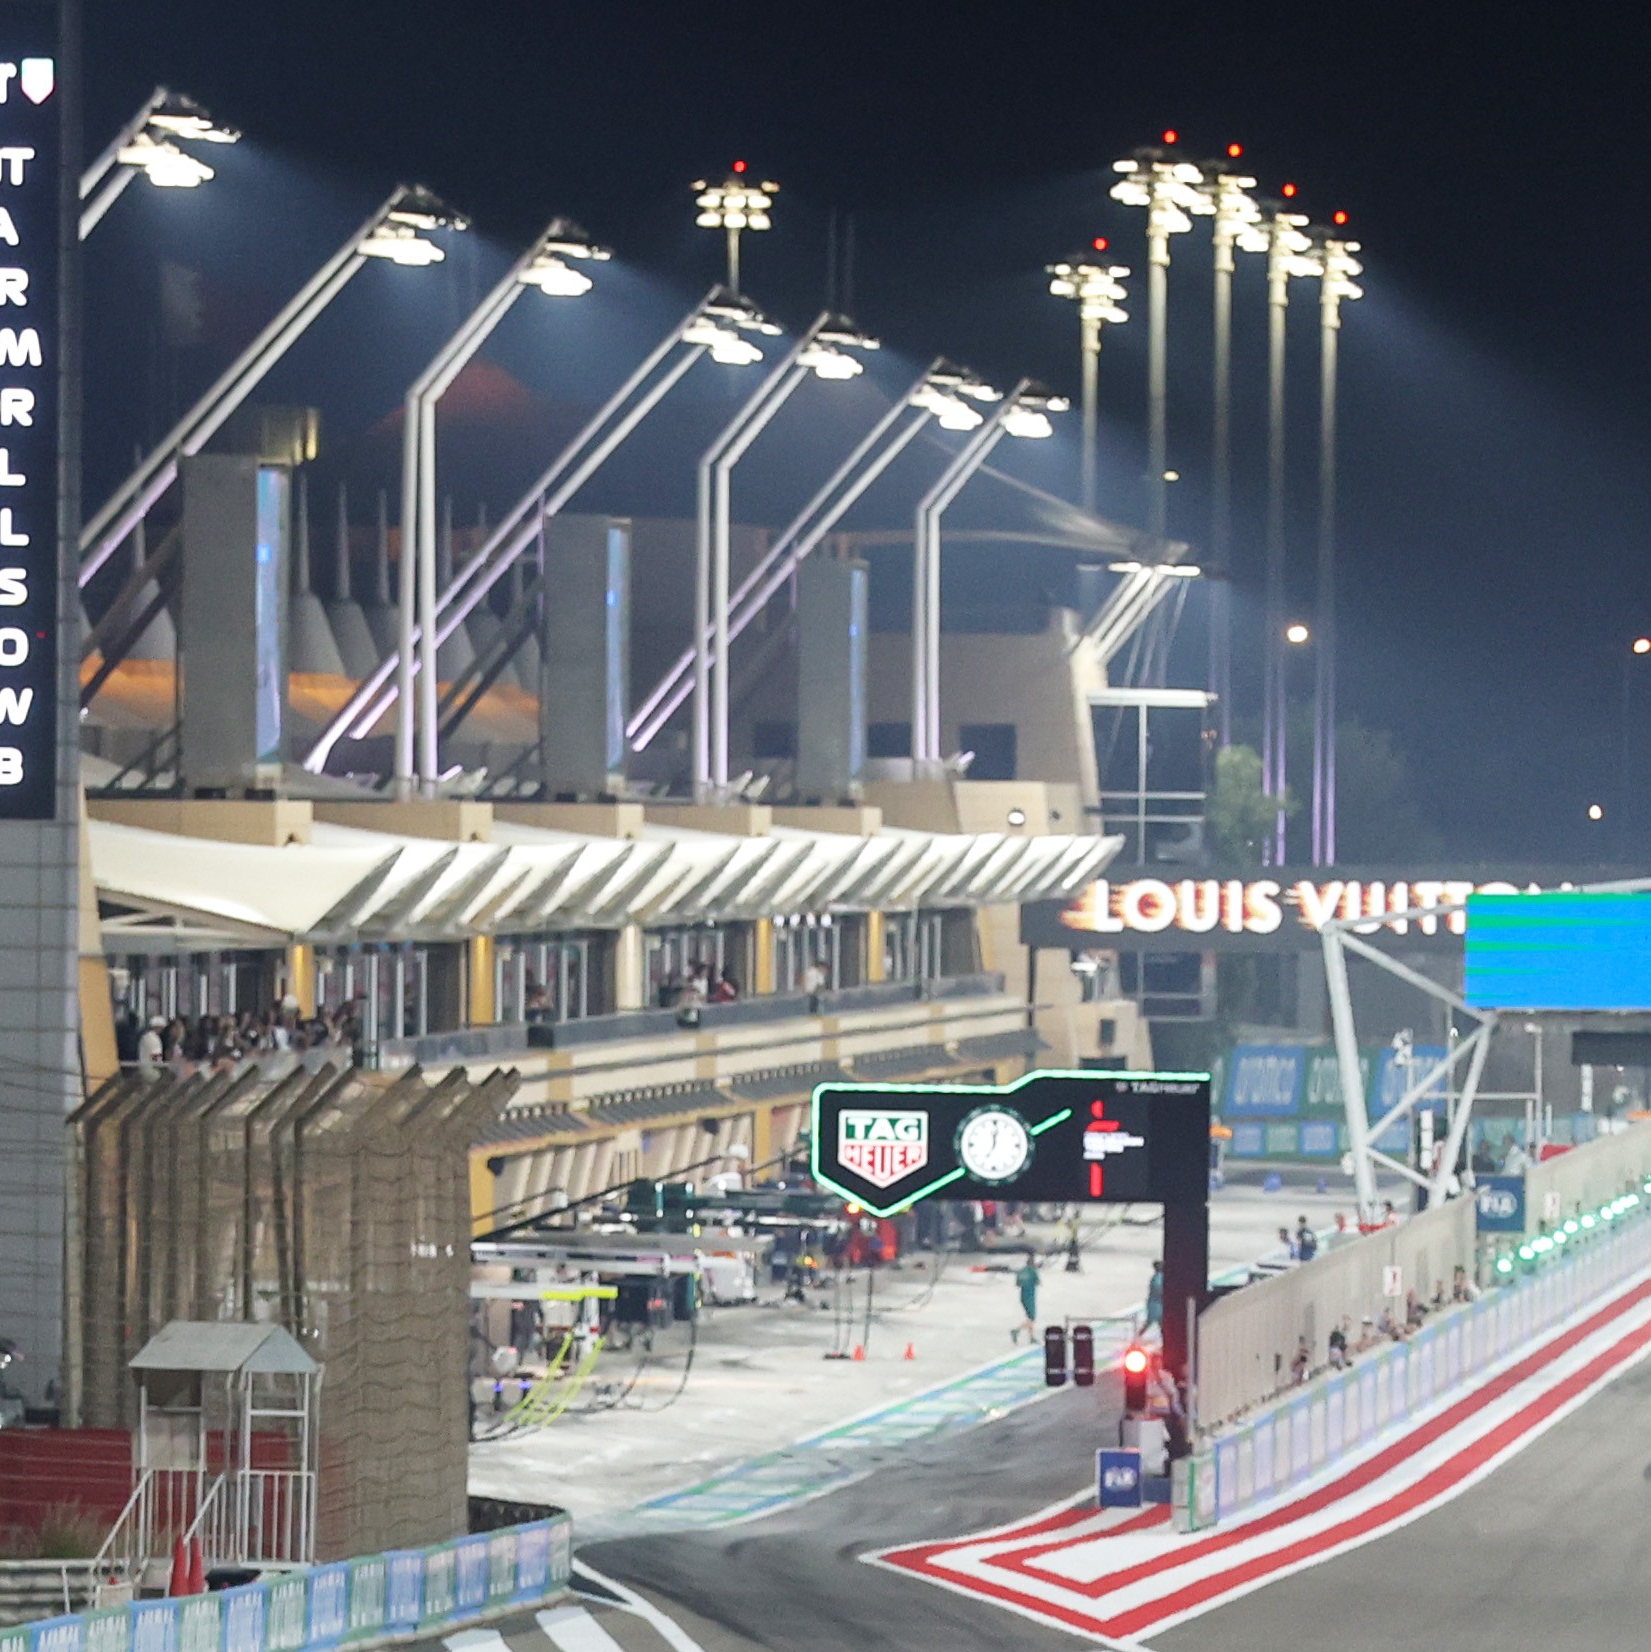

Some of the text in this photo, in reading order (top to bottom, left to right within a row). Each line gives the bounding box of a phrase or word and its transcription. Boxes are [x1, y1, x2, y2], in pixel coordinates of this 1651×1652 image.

[1083, 879, 1574, 935] LOUIS VUITT
[848, 1117, 920, 1141] TAG
[845, 1145, 922, 1174] HEUER
